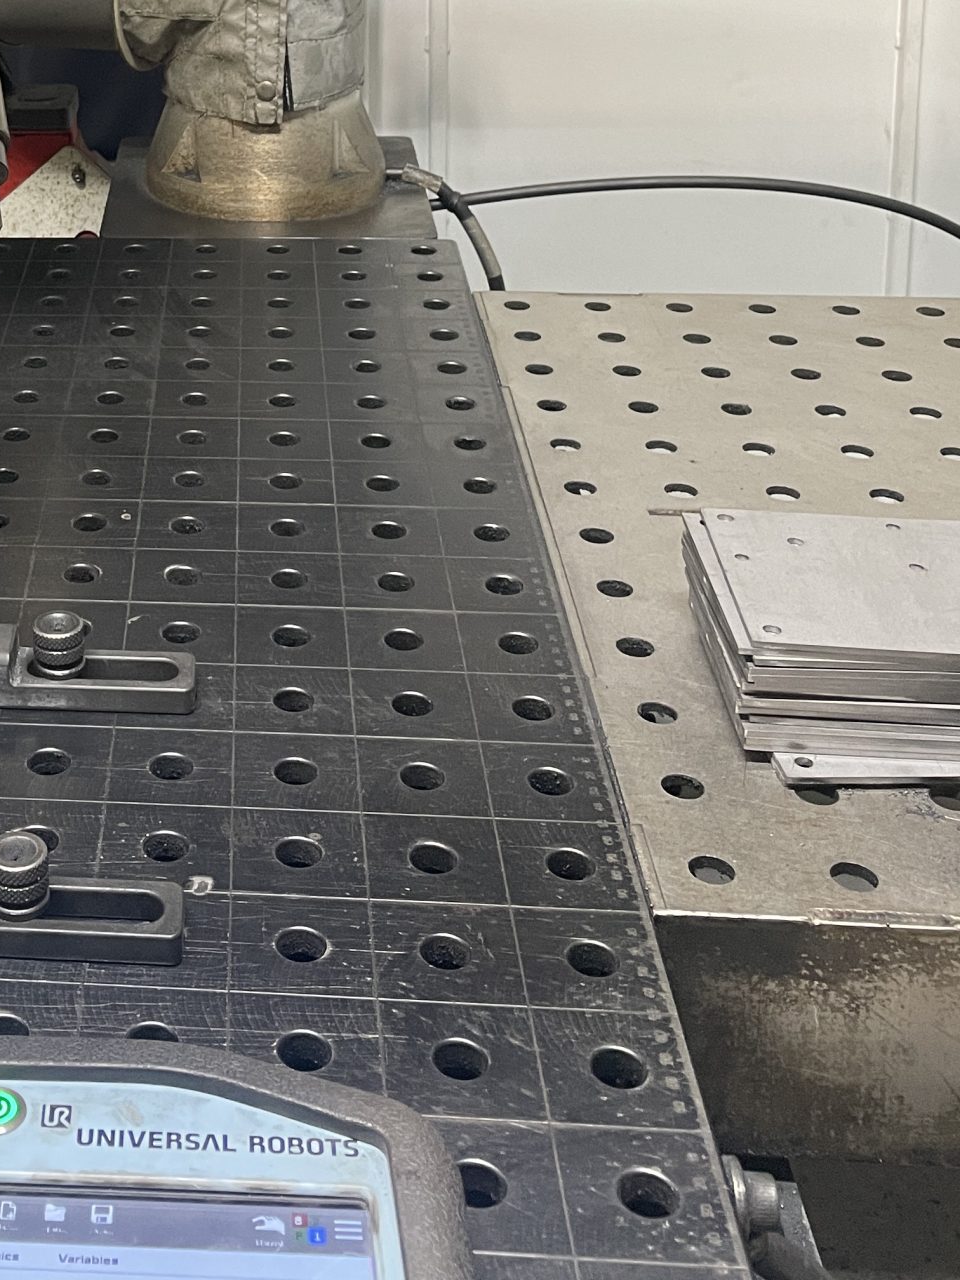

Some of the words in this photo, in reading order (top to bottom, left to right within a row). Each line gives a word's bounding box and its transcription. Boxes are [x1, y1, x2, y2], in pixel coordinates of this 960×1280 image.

[41, 1103, 72, 1129] UR
[76, 1127, 237, 1152] UNIVERSAL
[248, 1135, 360, 1157] ROBOTS
[58, 1253, 119, 1266] Variables
